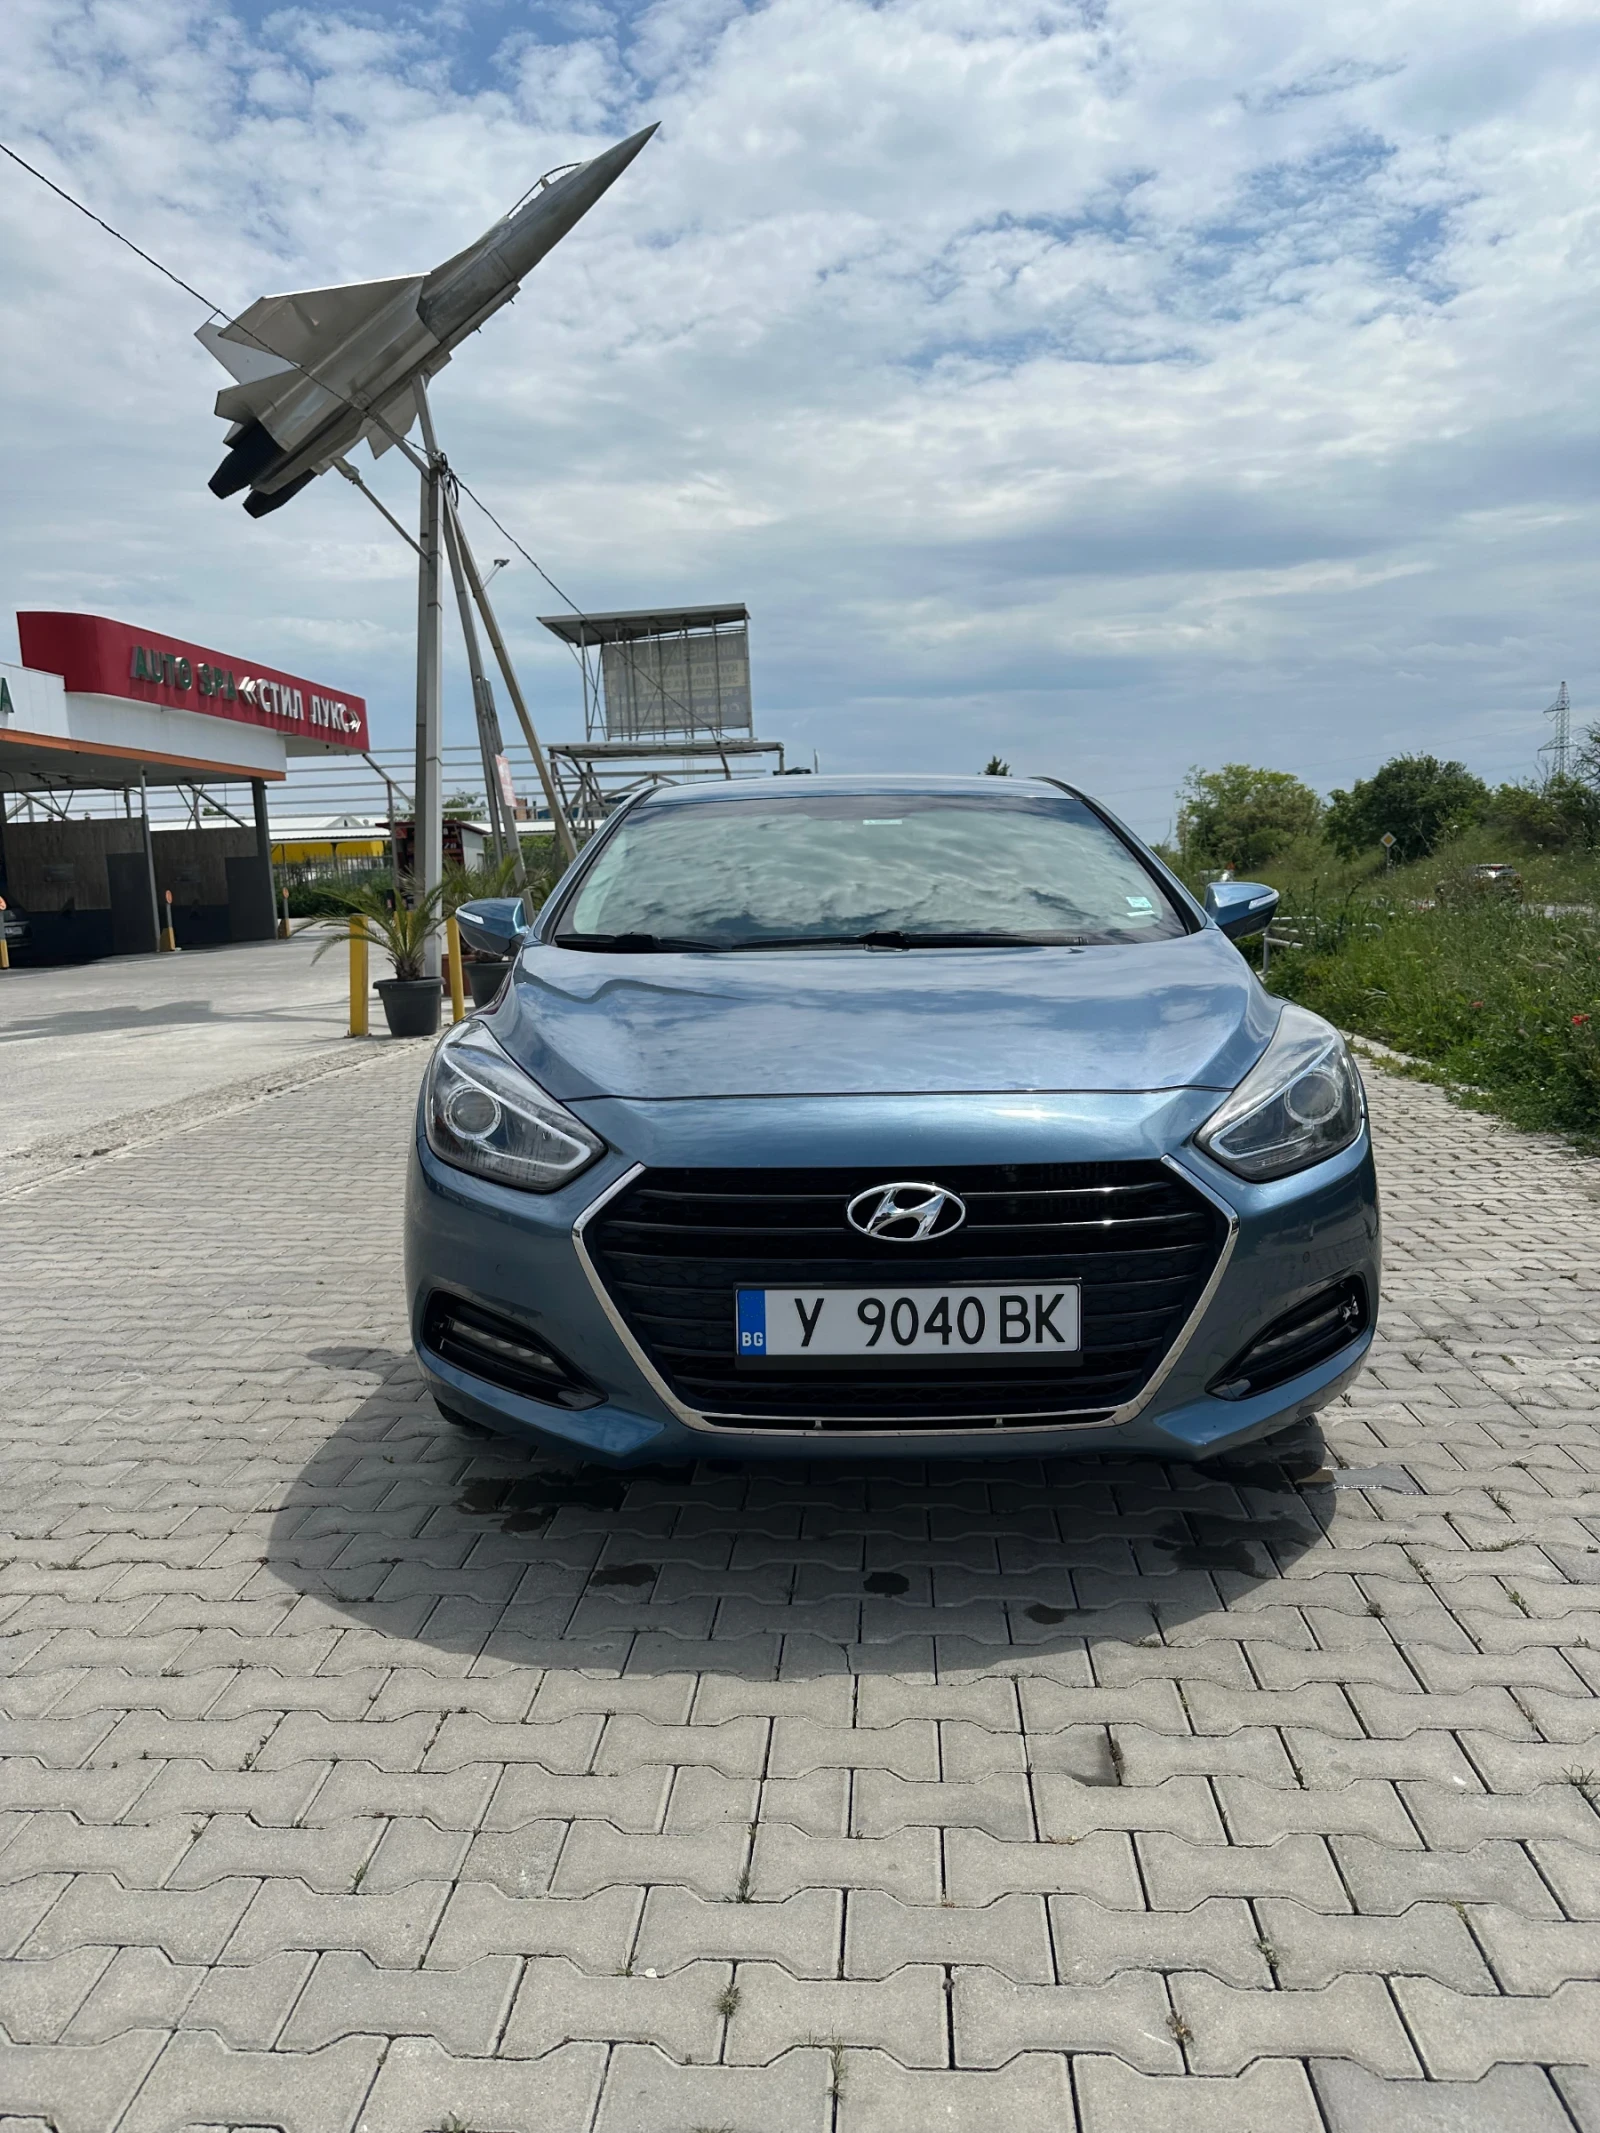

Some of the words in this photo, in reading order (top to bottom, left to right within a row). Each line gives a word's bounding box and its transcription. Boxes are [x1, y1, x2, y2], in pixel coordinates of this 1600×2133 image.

[131, 646, 192, 690] AUTO
[198, 663, 238, 700] SPA
[741, 1332, 763, 1347] BG
[857, 1296, 985, 1347] 9040
